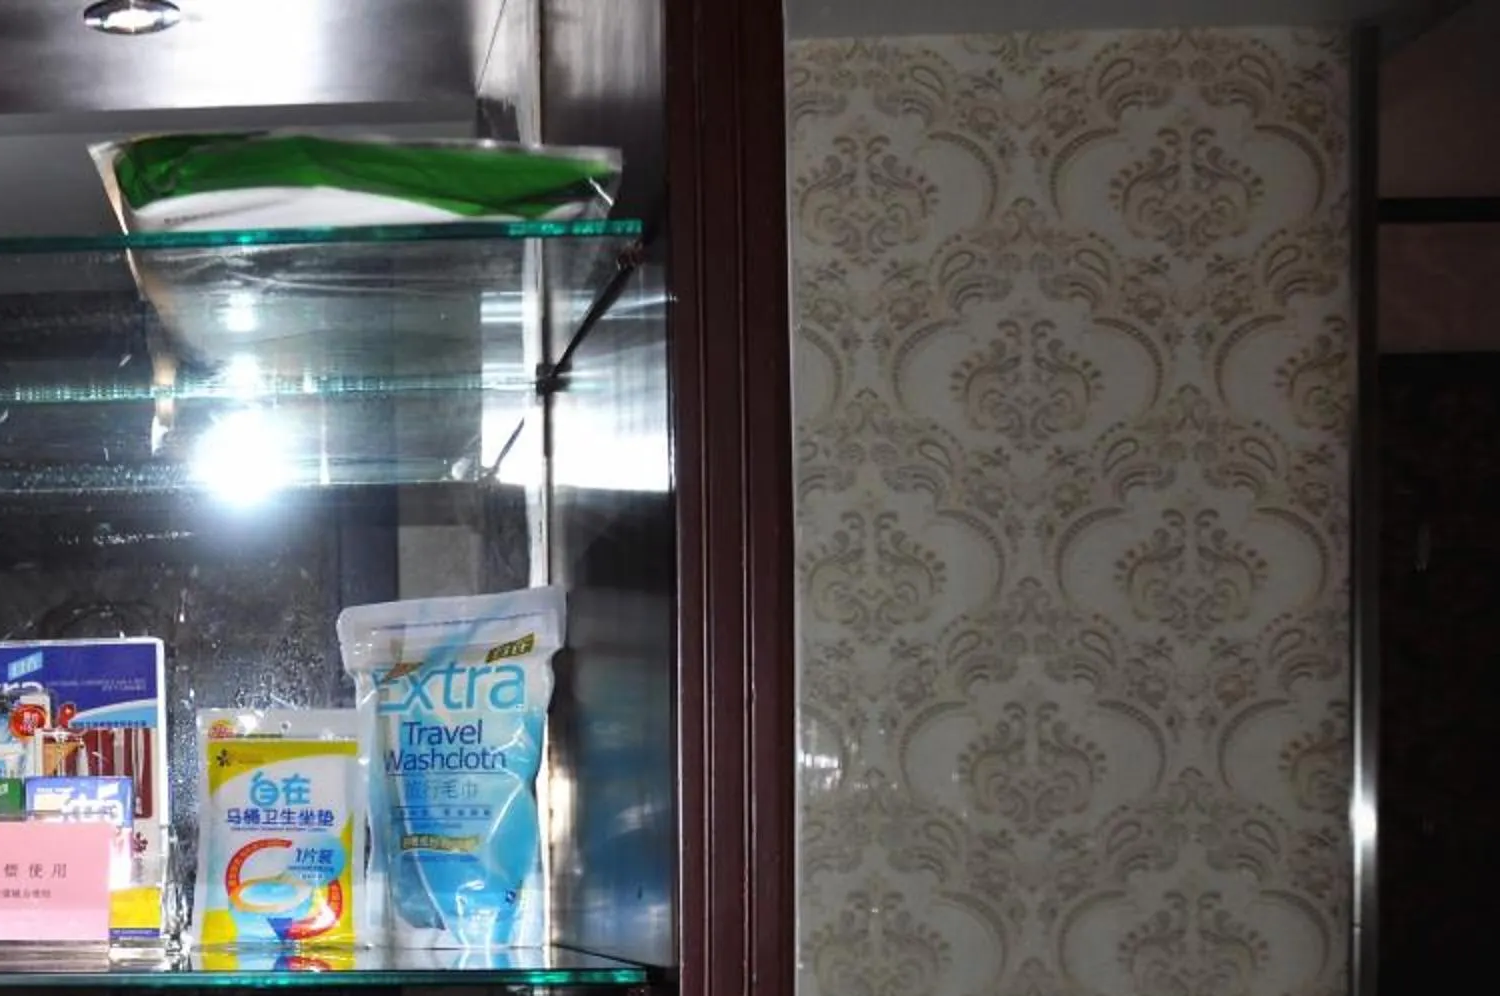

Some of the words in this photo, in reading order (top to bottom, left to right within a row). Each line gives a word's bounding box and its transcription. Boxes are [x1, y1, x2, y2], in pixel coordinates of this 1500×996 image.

[373, 660, 526, 711] Extra
[403, 719, 483, 745] Travel
[384, 746, 508, 772] Washcloth
[226, 808, 335, 826] 马桶卫生坐垫
